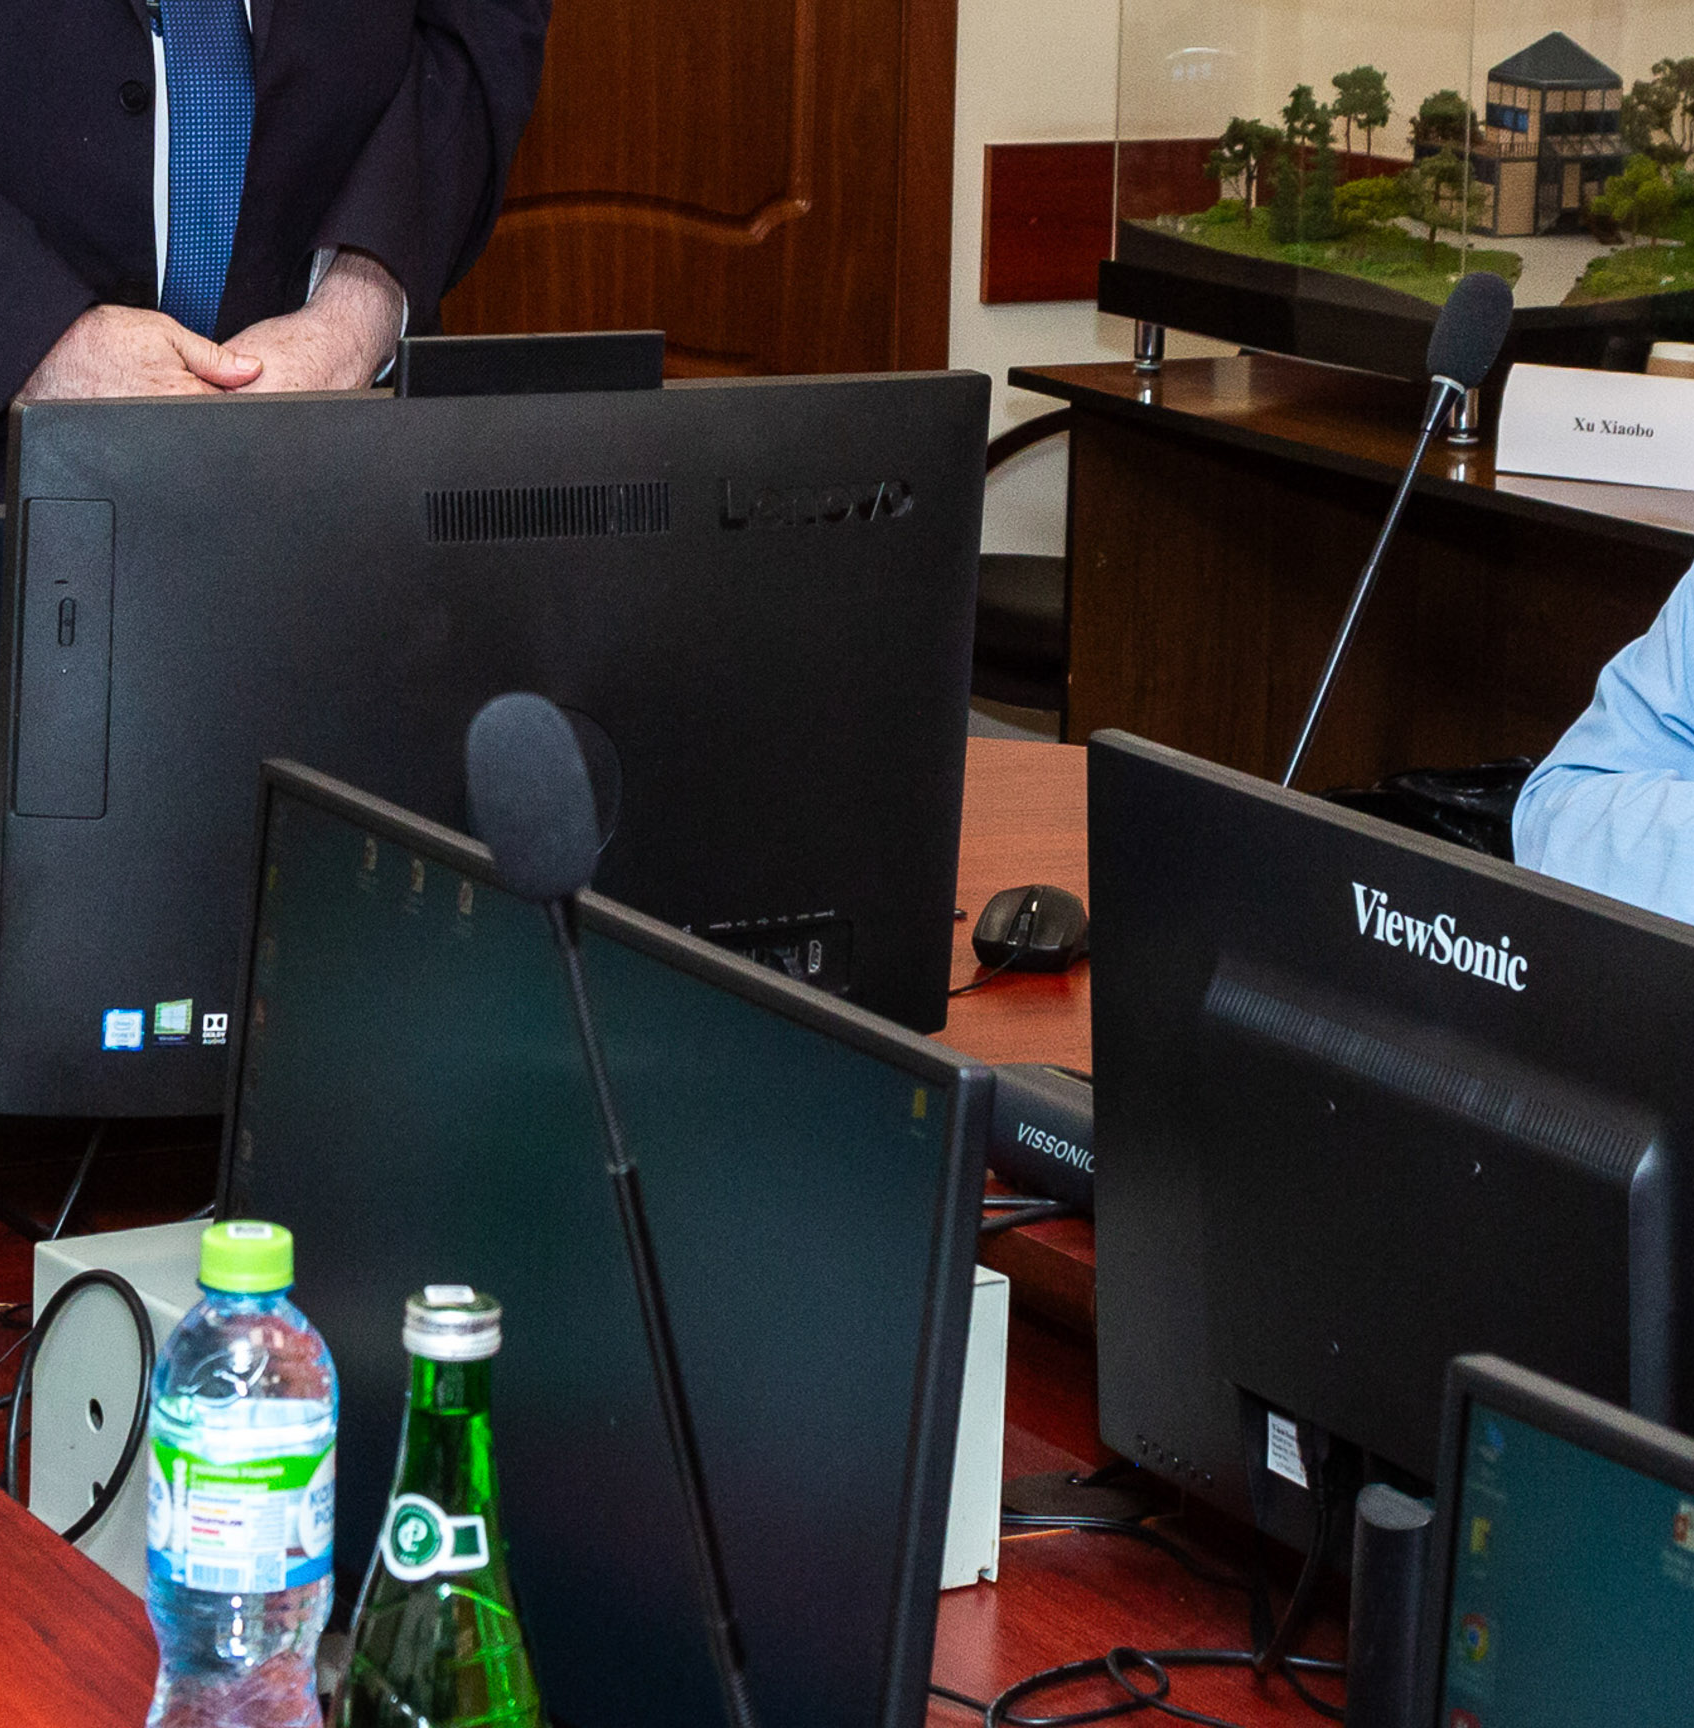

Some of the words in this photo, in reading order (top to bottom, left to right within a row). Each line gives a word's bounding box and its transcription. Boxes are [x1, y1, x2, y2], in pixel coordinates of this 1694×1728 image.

[1573, 417, 1595, 432] Xu
[1600, 419, 1654, 438] Xiaobo
[1352, 881, 1528, 992] ViewSonic
[1017, 1122, 1095, 1173] VISSONIC
